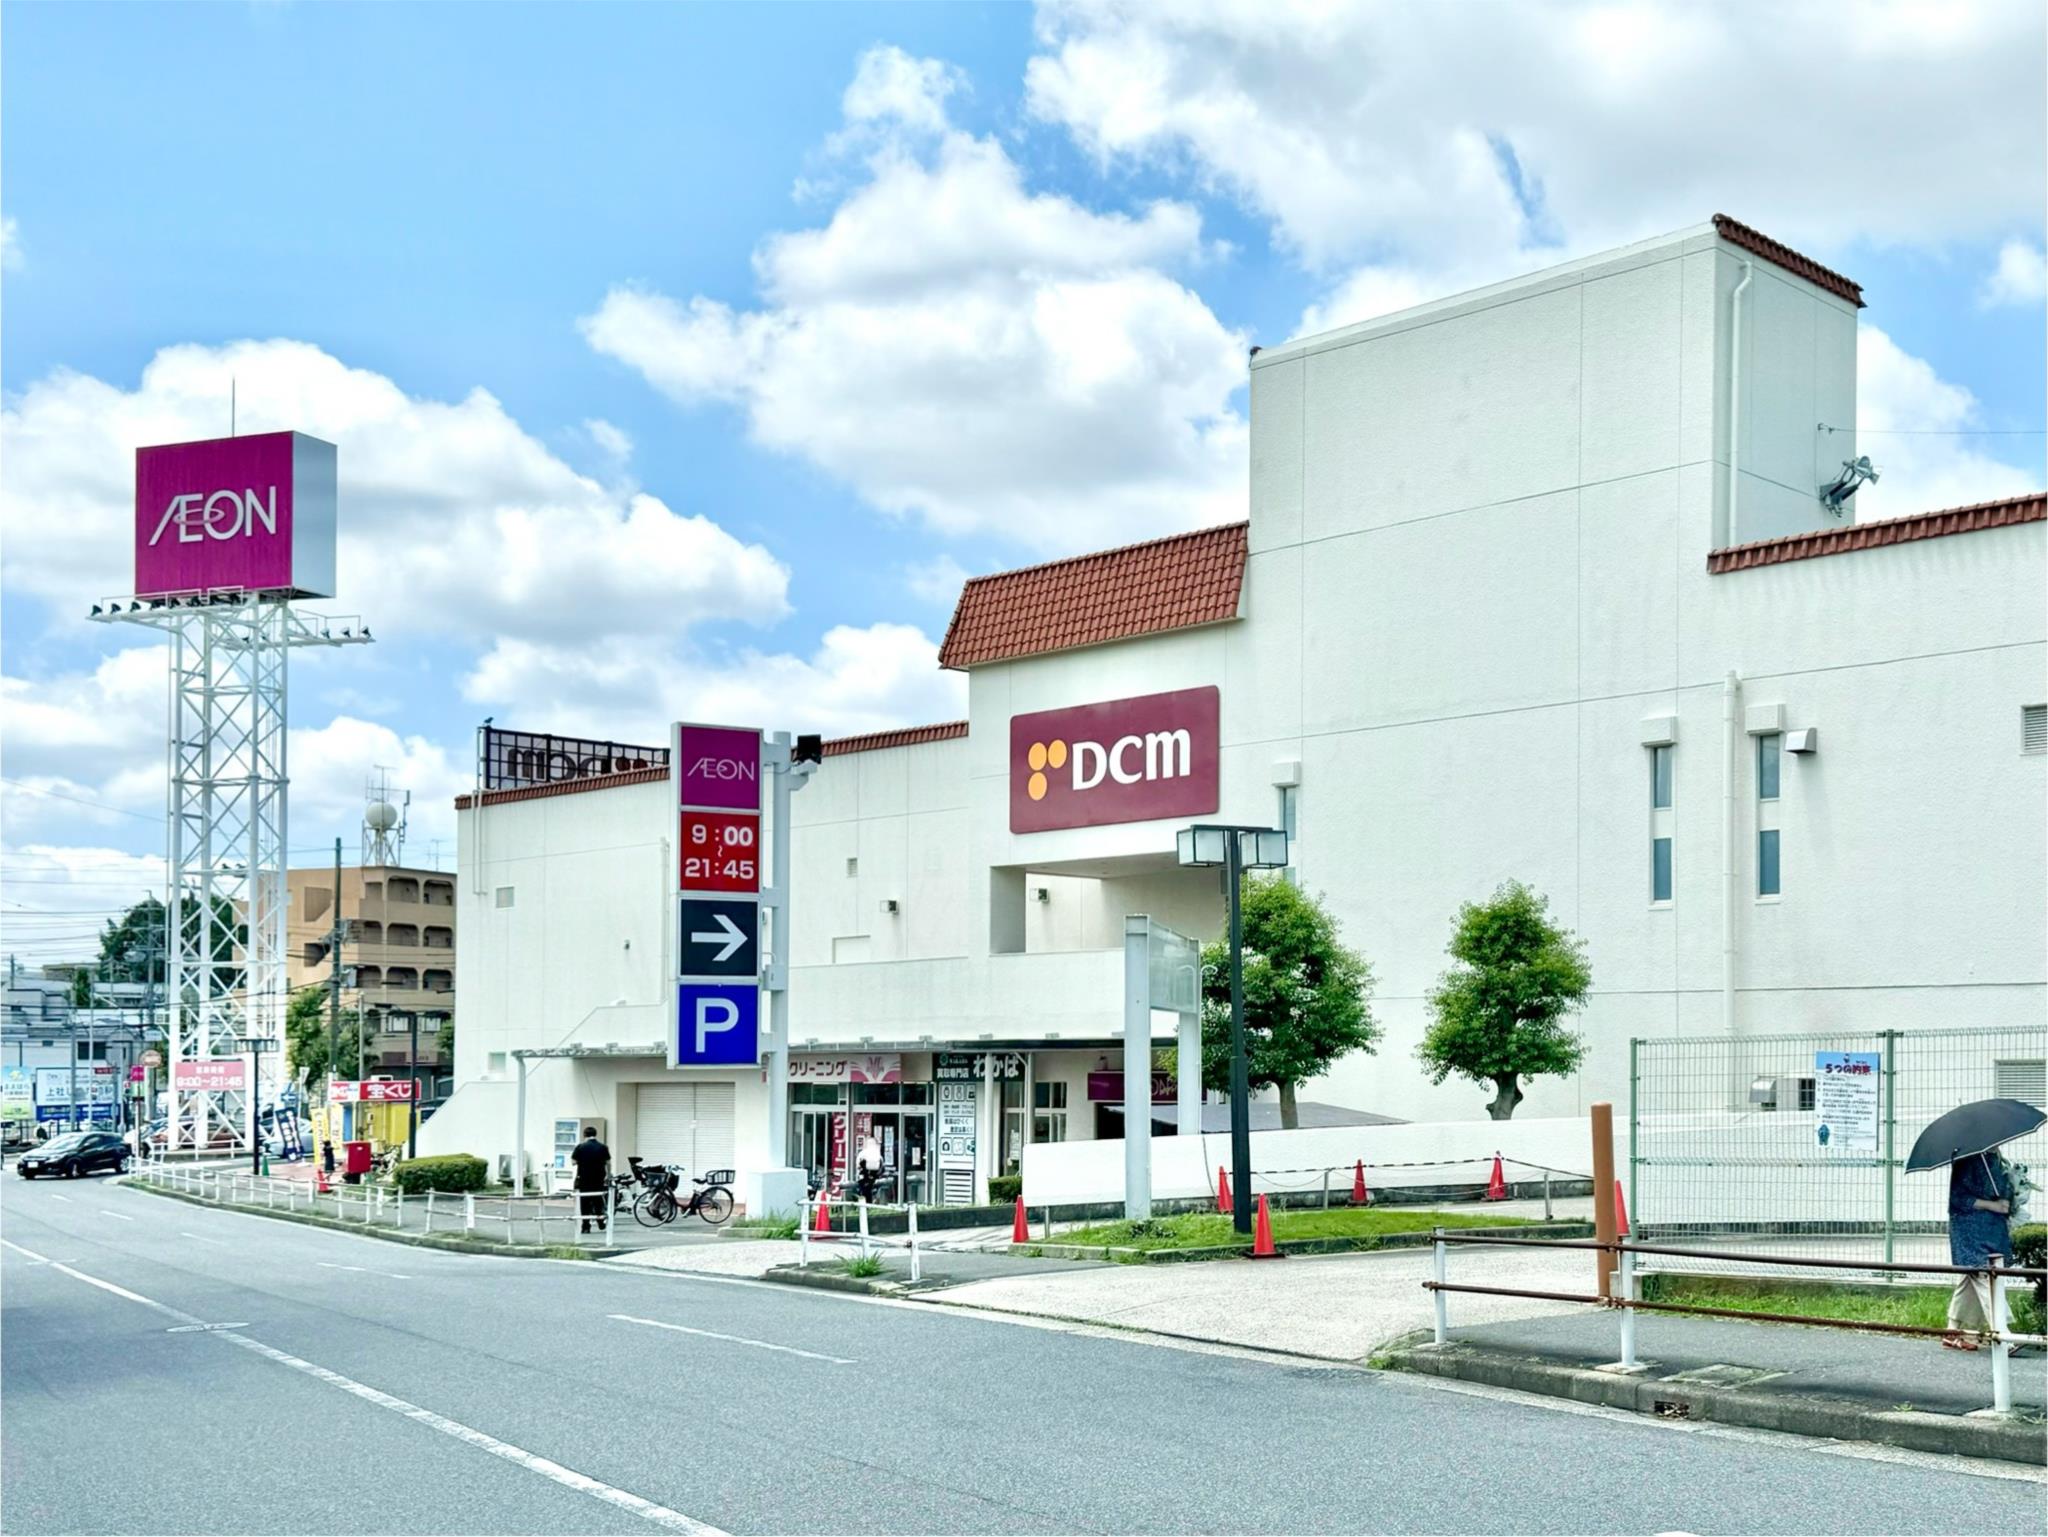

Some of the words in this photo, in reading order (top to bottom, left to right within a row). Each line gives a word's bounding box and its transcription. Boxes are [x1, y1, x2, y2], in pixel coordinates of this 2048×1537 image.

[684, 857, 754, 880] 21:45
[695, 998, 740, 1053] P
[790, 1060, 847, 1076] クリーニング
[367, 1083, 412, 1099] 宝くじ
